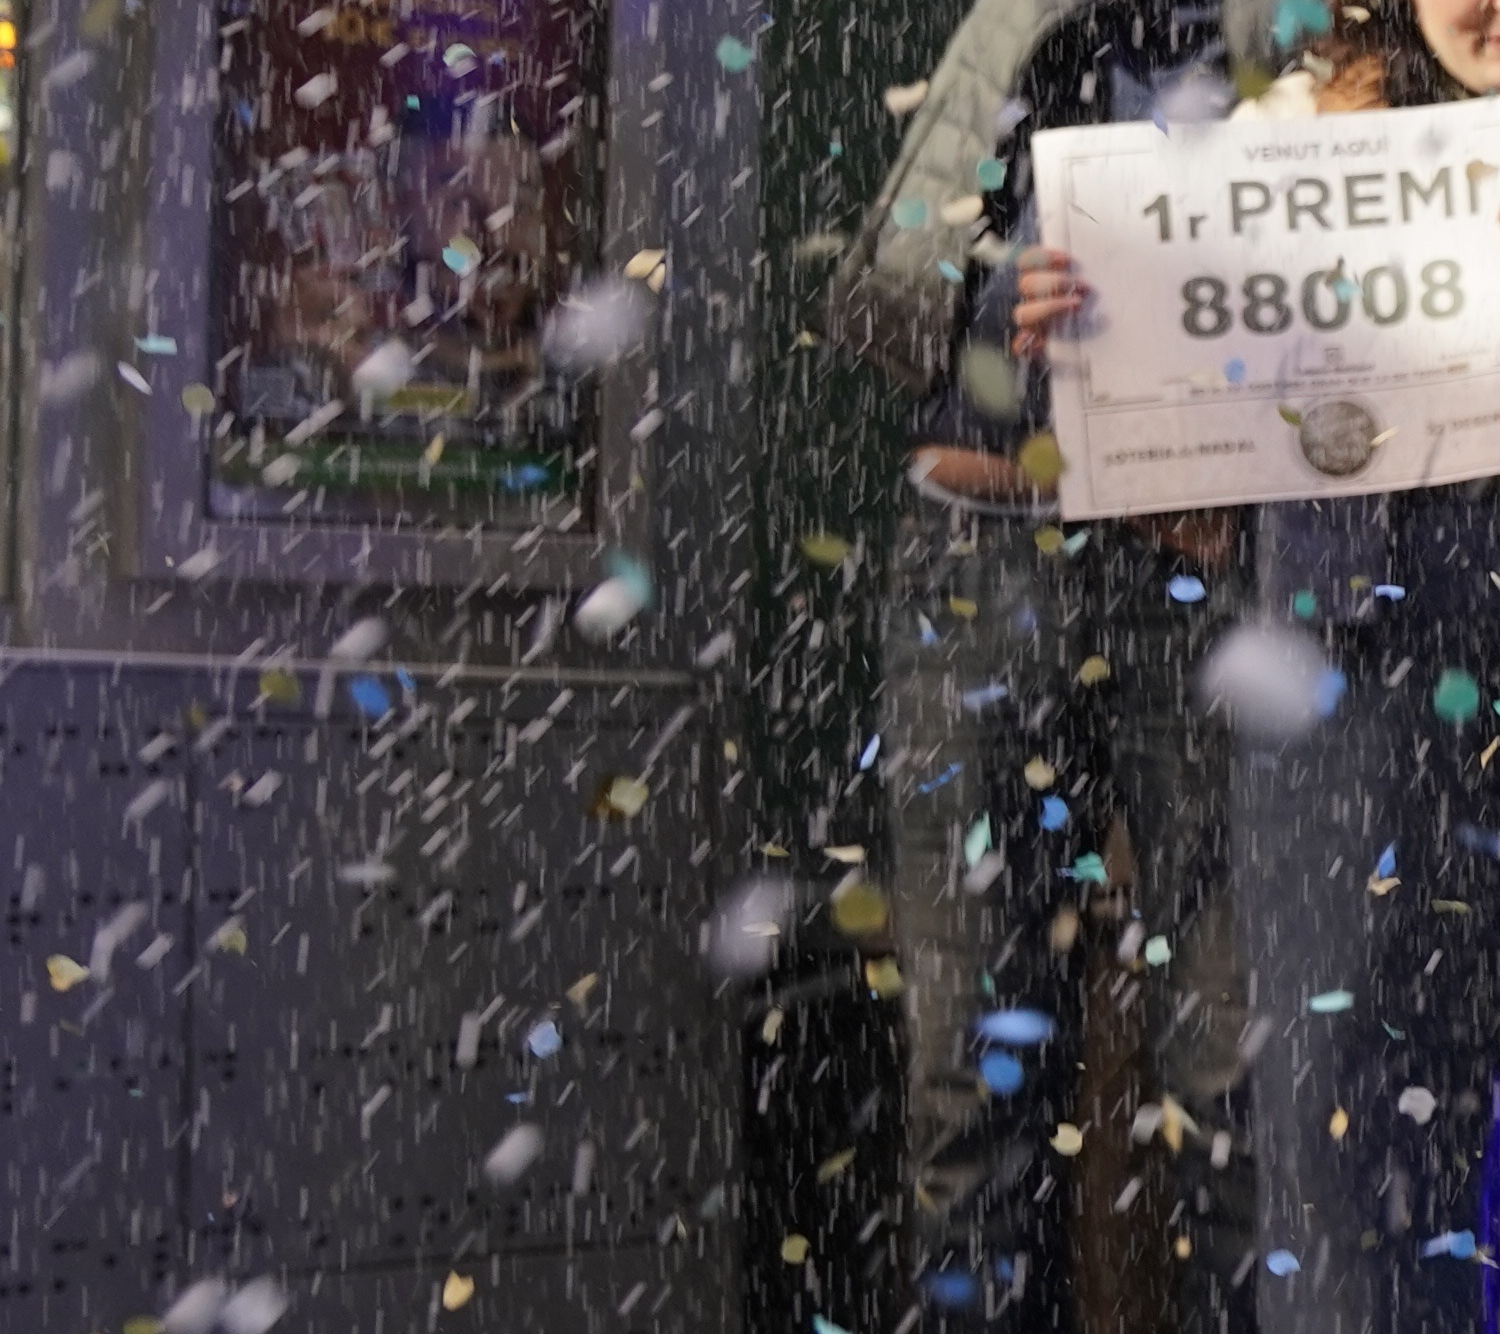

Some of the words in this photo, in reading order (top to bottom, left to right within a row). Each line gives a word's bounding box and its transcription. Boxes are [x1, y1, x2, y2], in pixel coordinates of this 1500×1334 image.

[1142, 192, 1211, 245] 1r
[1229, 165, 1486, 236] PREMI
[1179, 259, 1467, 341] 88008
